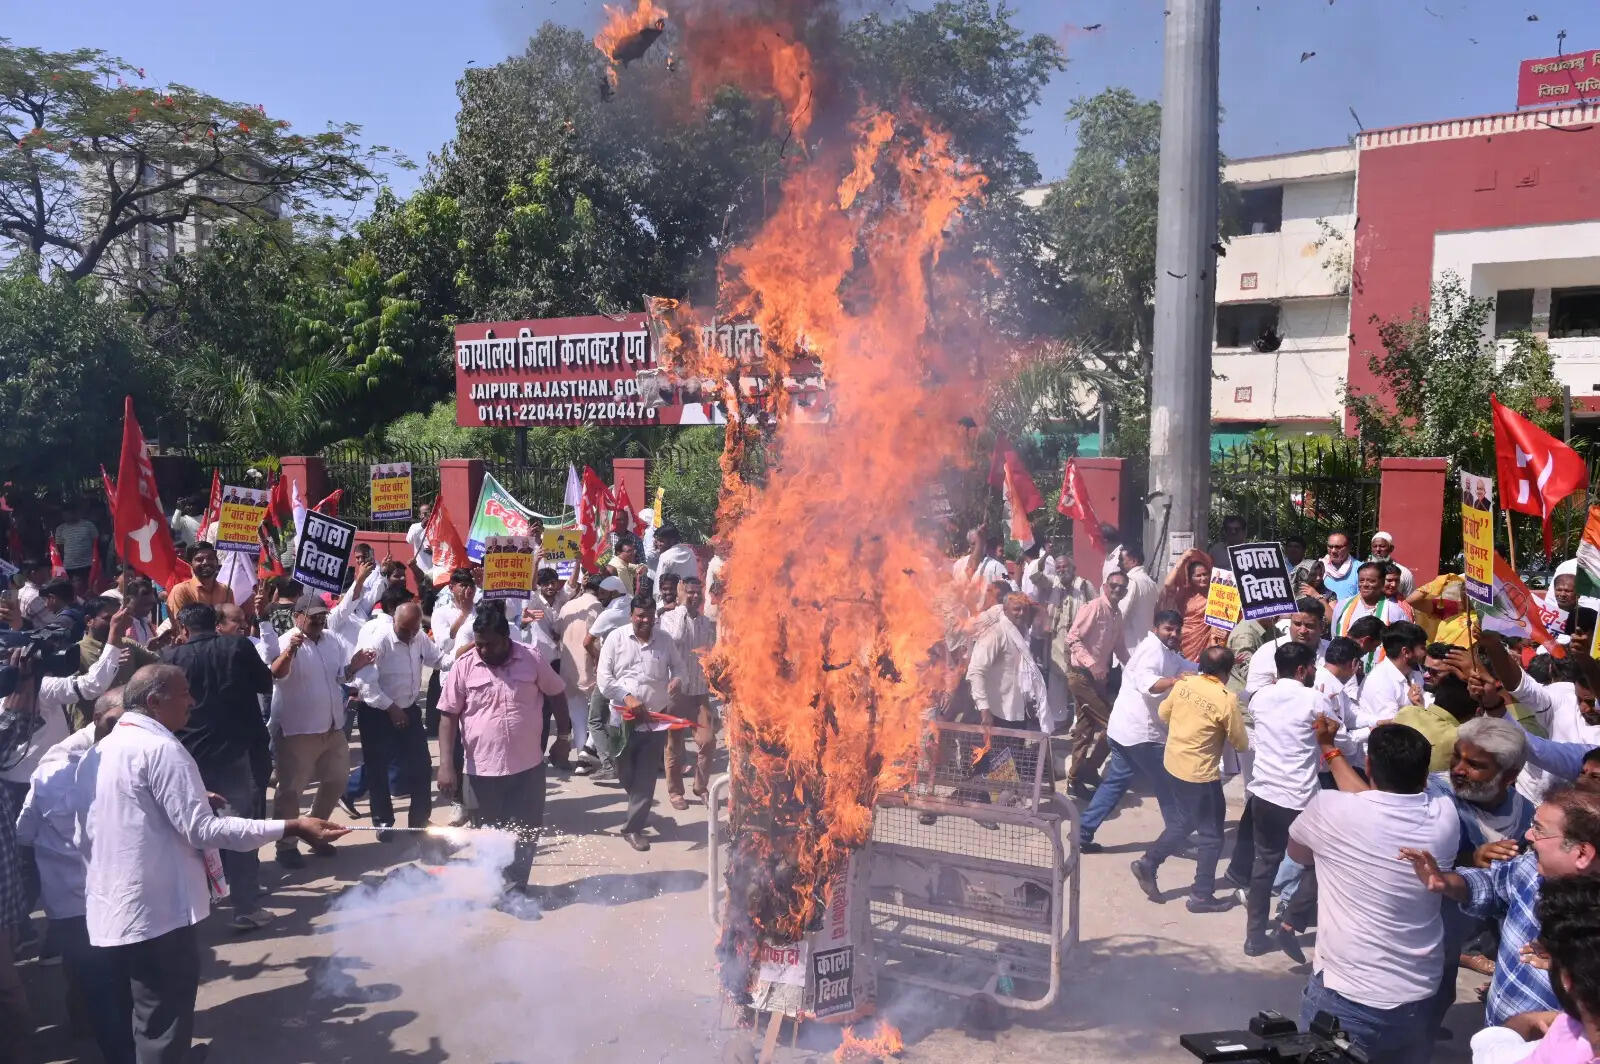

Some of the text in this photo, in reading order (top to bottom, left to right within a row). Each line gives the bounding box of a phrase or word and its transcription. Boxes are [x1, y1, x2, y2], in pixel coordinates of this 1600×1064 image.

[456, 329, 517, 370] कार्यालय
[518, 327, 558, 368] जिला
[559, 332, 620, 366] कलक्टर
[622, 321, 648, 363] एवं
[308, 516, 351, 549] काला
[300, 540, 344, 578] दिवस
[1234, 548, 1280, 571] काला
[1241, 574, 1288, 603] दिवस
[817, 950, 851, 976] काला
[818, 977, 850, 1003] दिवस
